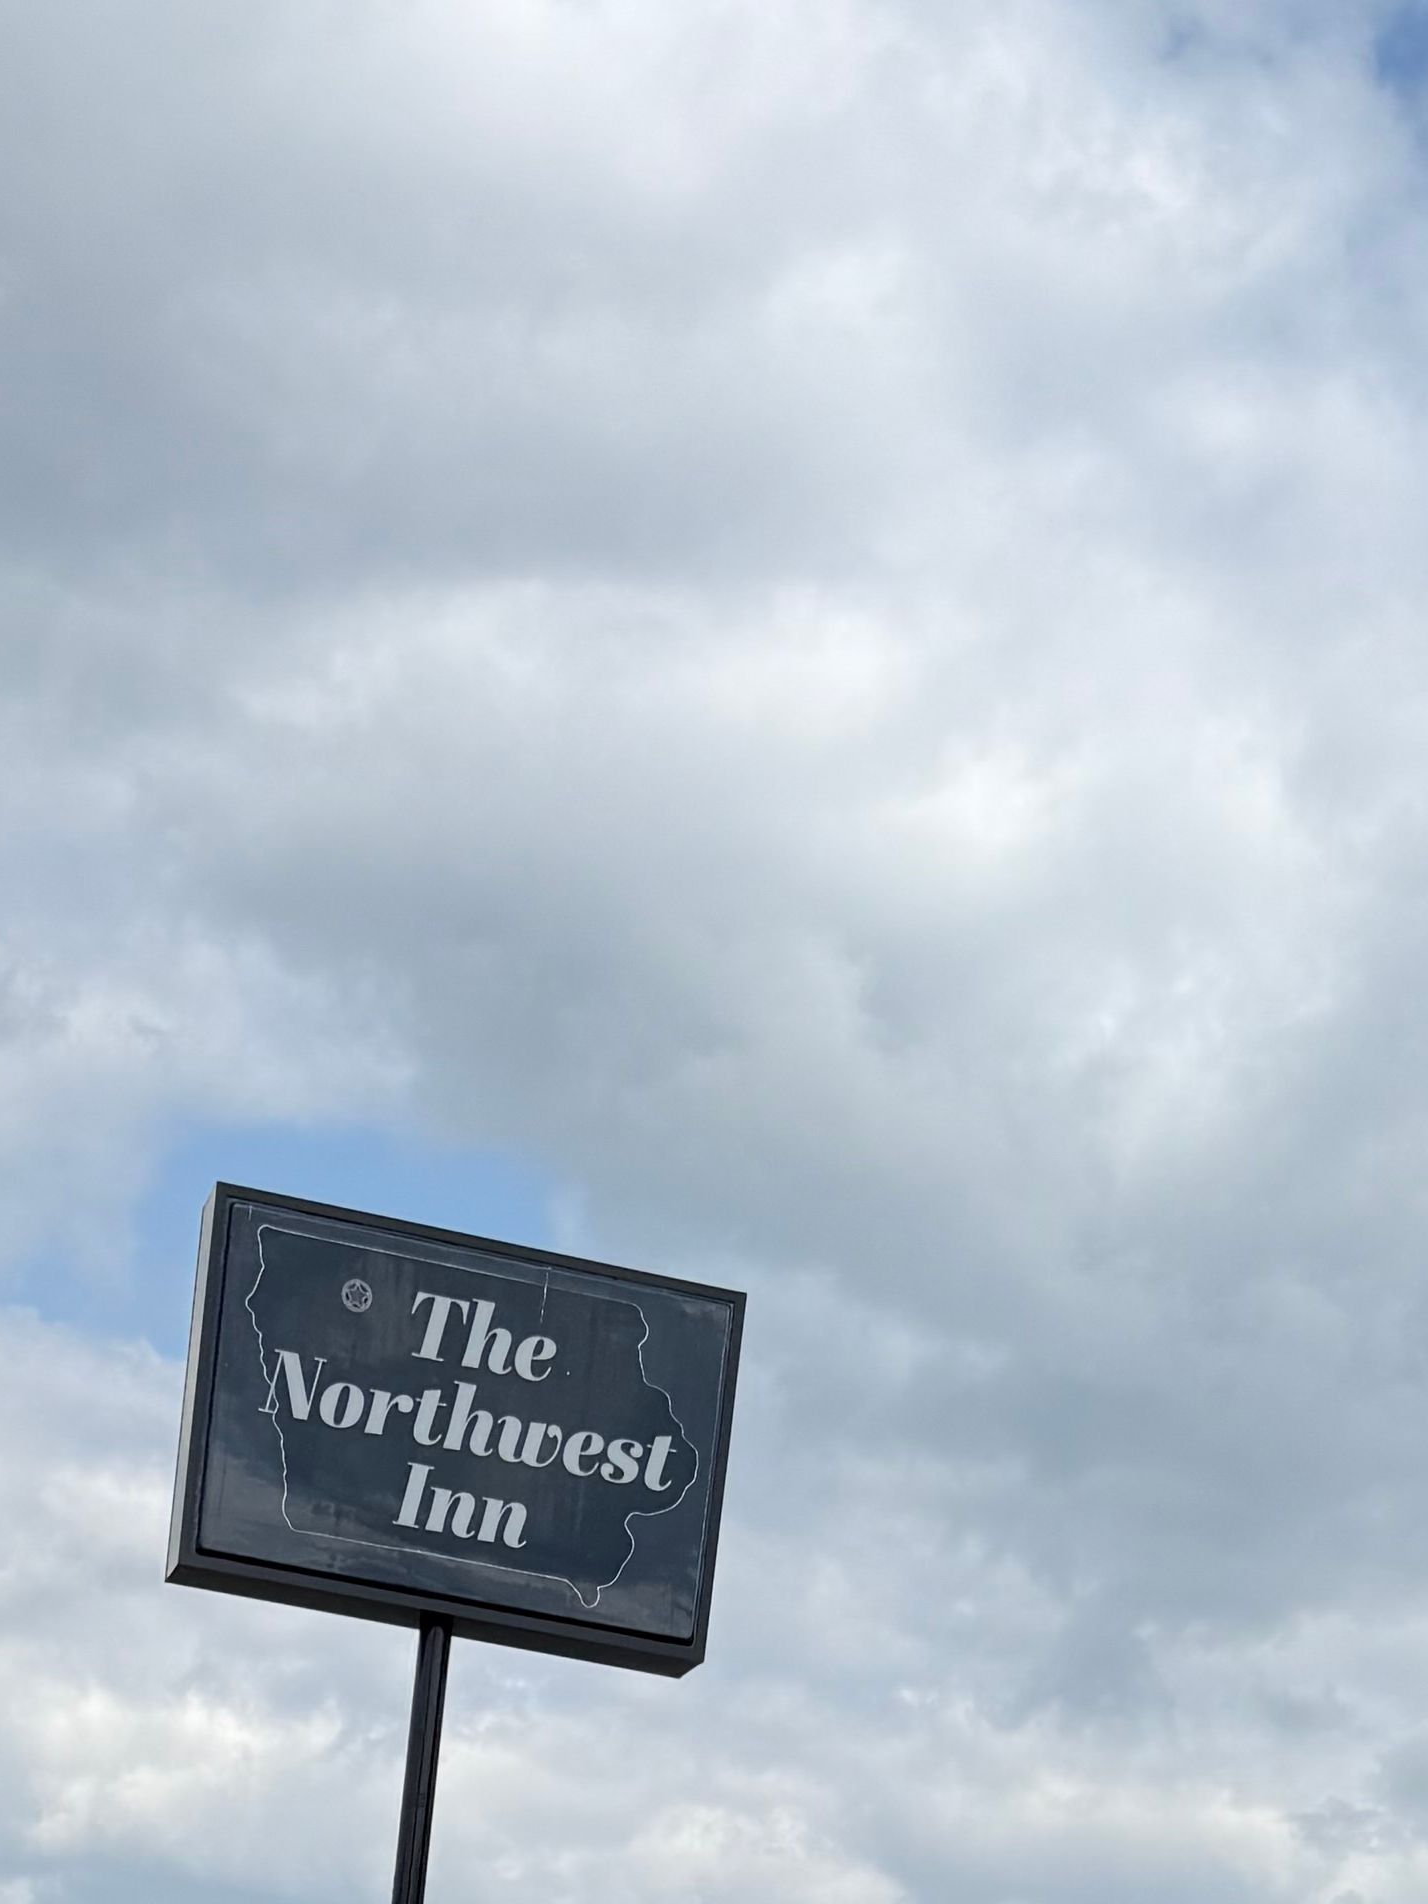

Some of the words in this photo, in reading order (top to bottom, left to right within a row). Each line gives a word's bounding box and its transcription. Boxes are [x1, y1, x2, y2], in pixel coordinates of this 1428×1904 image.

[410, 1290, 558, 1382] The
[257, 1348, 677, 1493] Northwest
[392, 1461, 529, 1550] Inn
